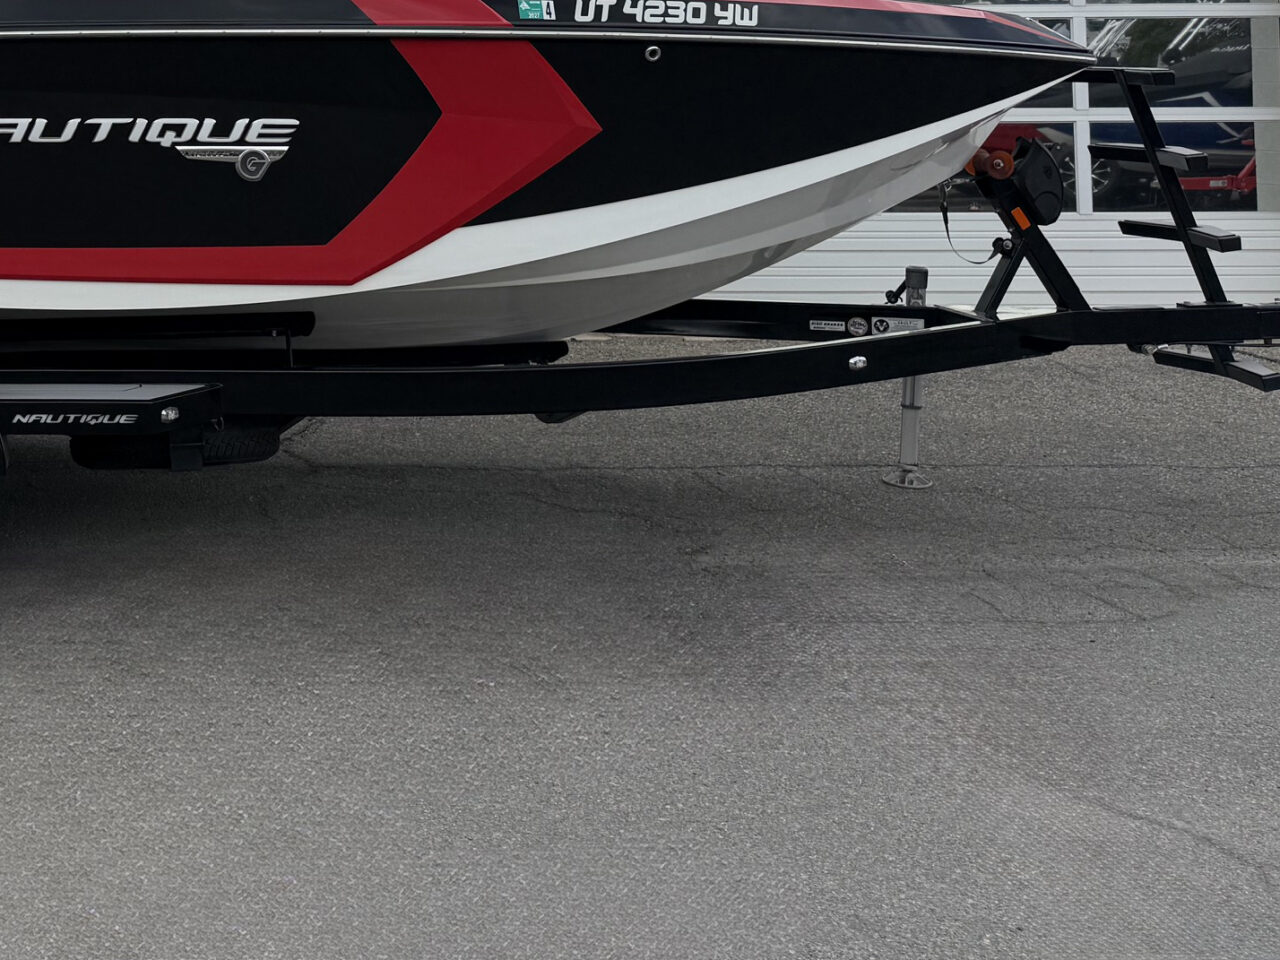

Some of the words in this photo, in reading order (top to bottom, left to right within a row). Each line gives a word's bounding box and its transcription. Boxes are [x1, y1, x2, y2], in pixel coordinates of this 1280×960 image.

[545, 1, 552, 19] 4
[623, 0, 707, 24] 4230
[714, 2, 759, 27] YW
[12, 414, 139, 425] NAUTIQUE
